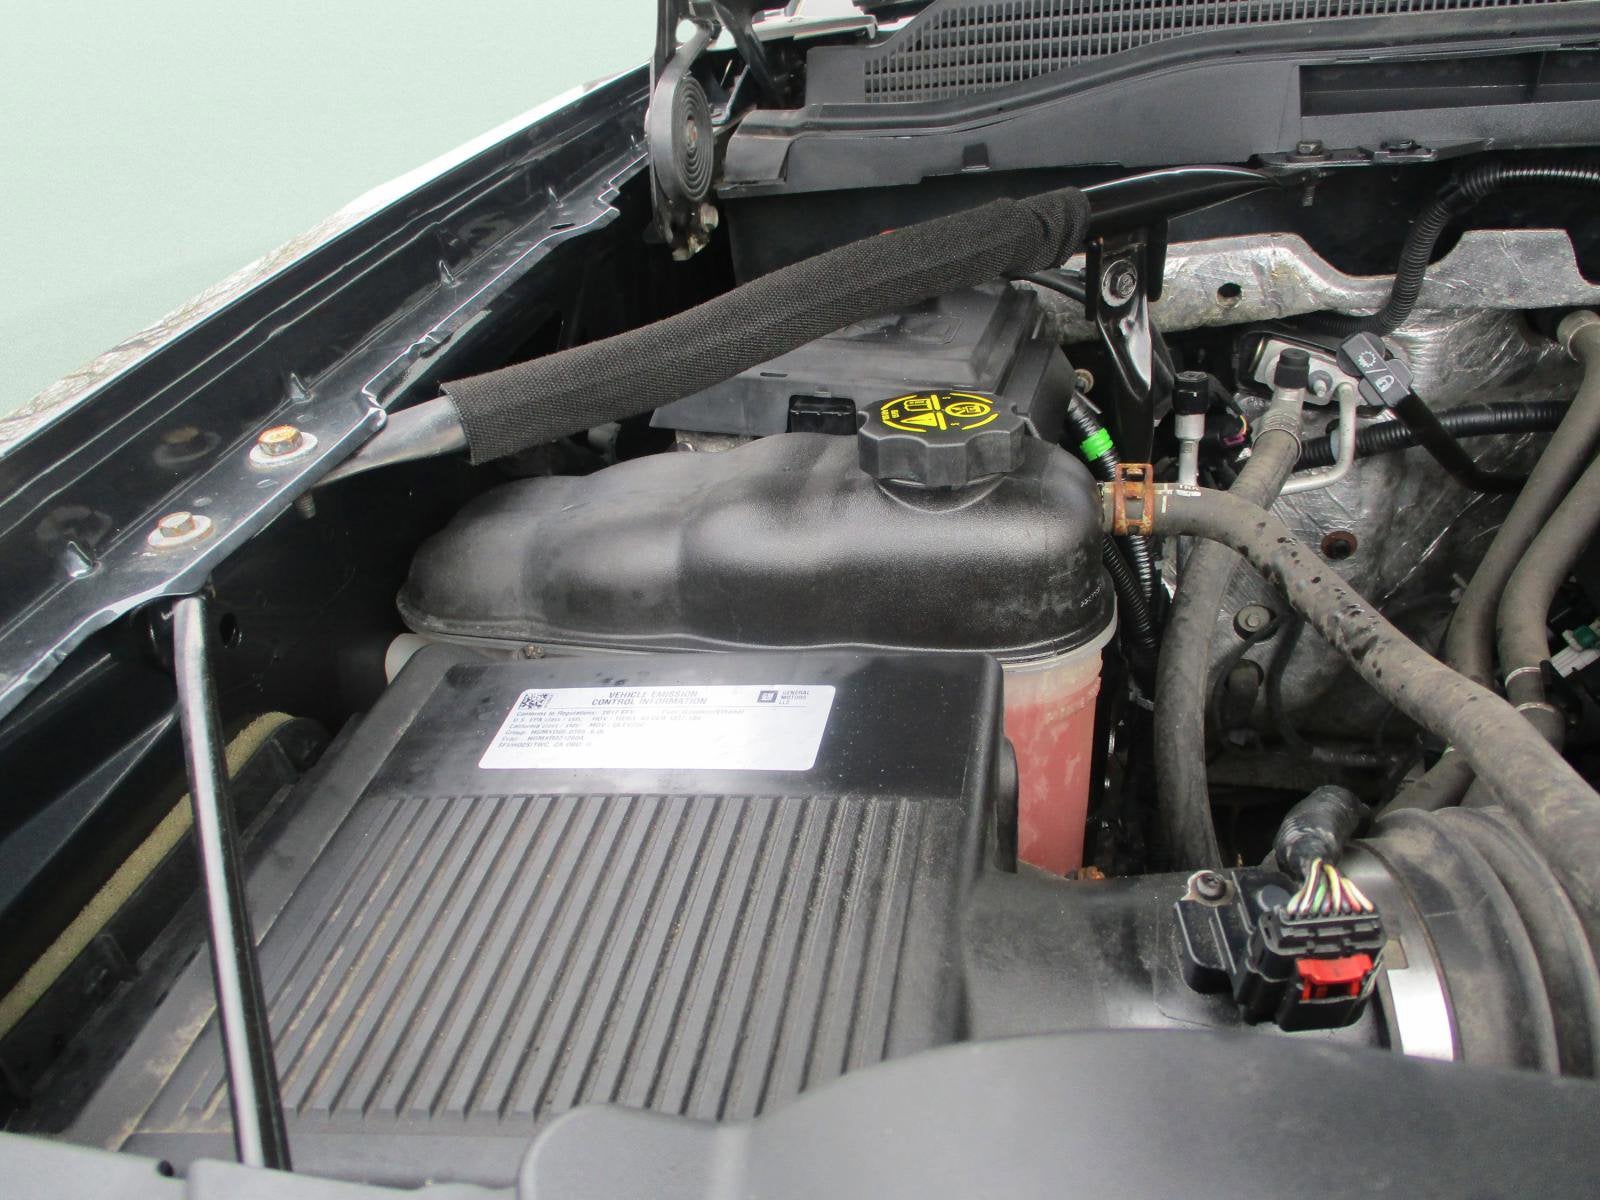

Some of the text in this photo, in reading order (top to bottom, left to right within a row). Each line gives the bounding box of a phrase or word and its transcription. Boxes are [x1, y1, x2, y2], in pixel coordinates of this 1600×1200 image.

[650, 690, 698, 698] EMISSION
[592, 697, 708, 706] CONTROL INFORMATION
